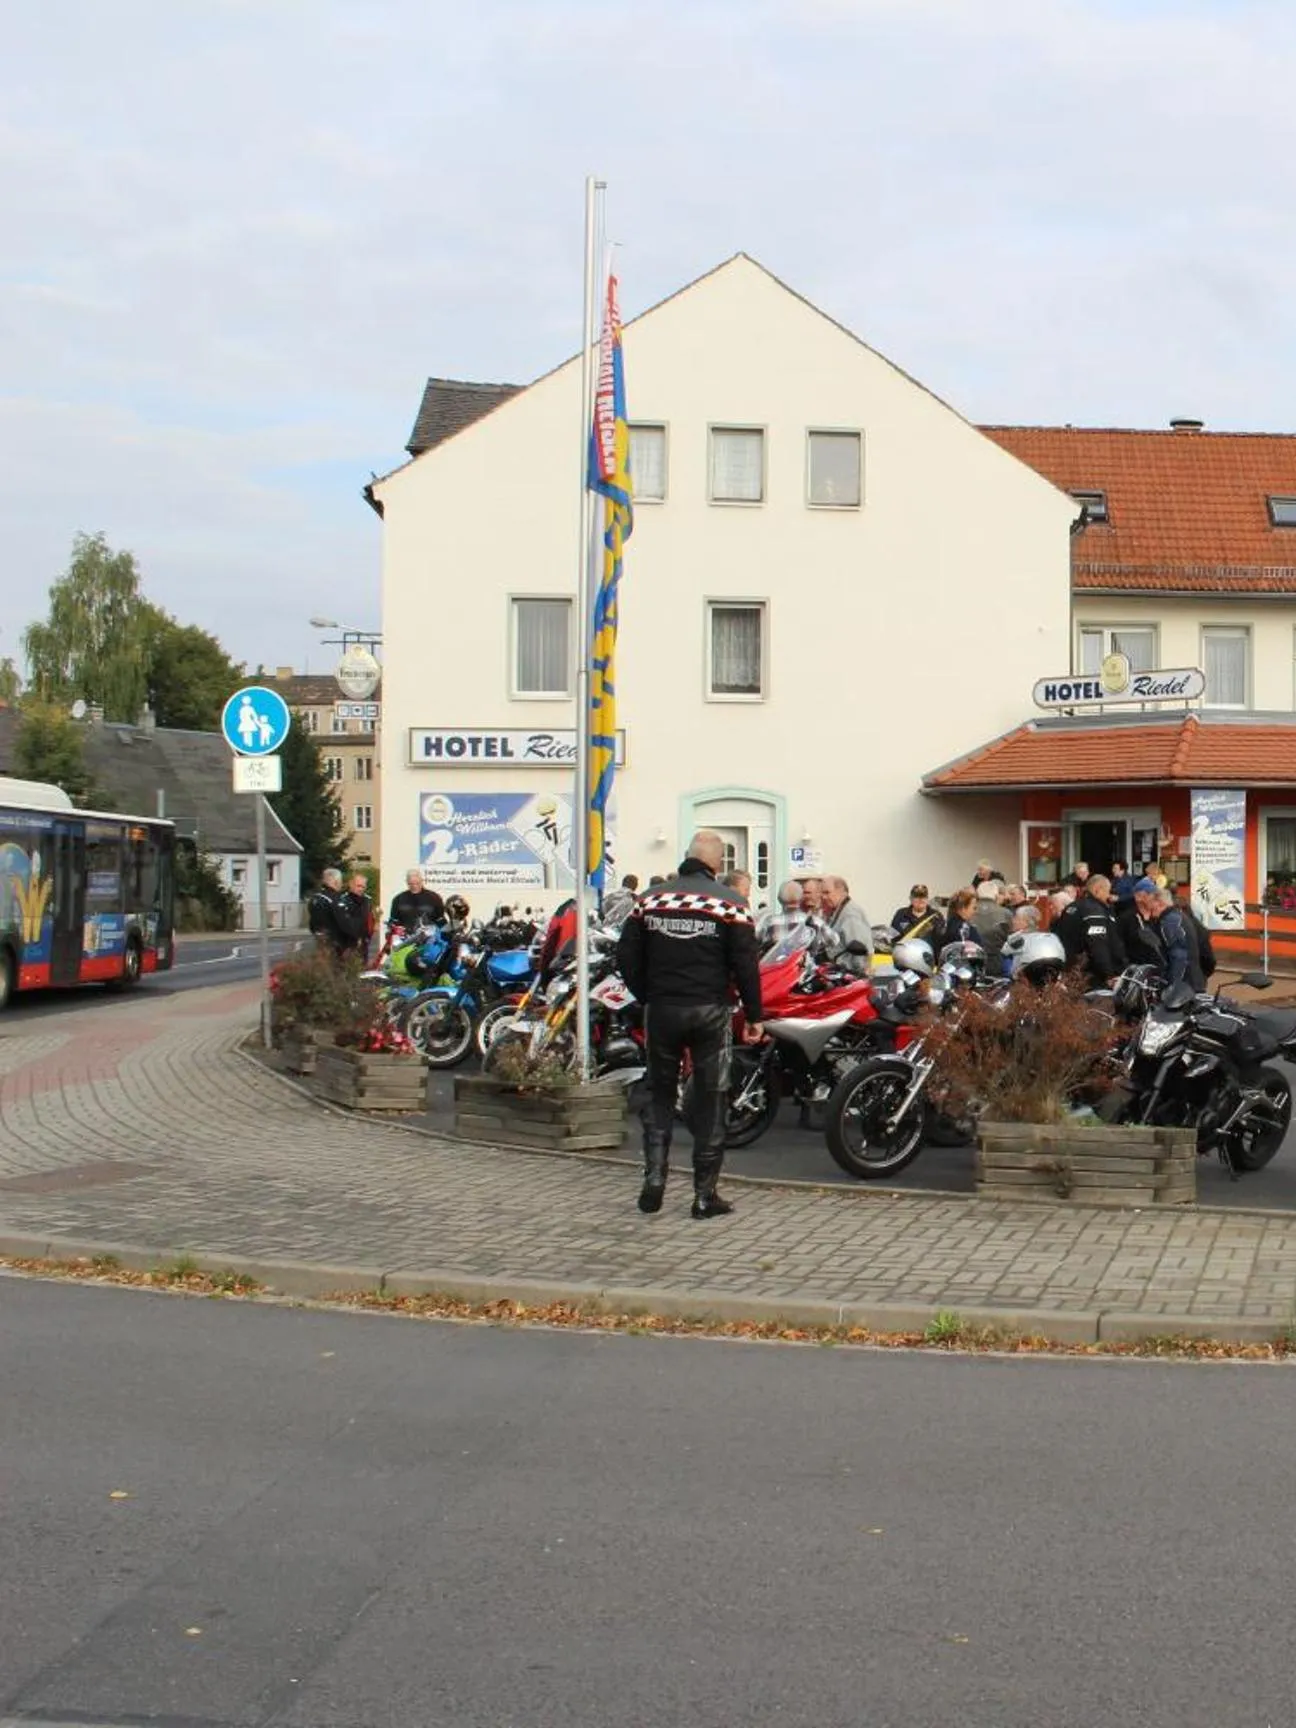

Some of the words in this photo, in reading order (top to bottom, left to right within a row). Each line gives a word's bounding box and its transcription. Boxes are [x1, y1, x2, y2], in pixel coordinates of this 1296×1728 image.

[1045, 682, 1103, 701] HOTEL
[1131, 674, 1191, 697] Riedel
[424, 736, 514, 758] HOTEL
[644, 915, 717, 937] TRIUMPH
